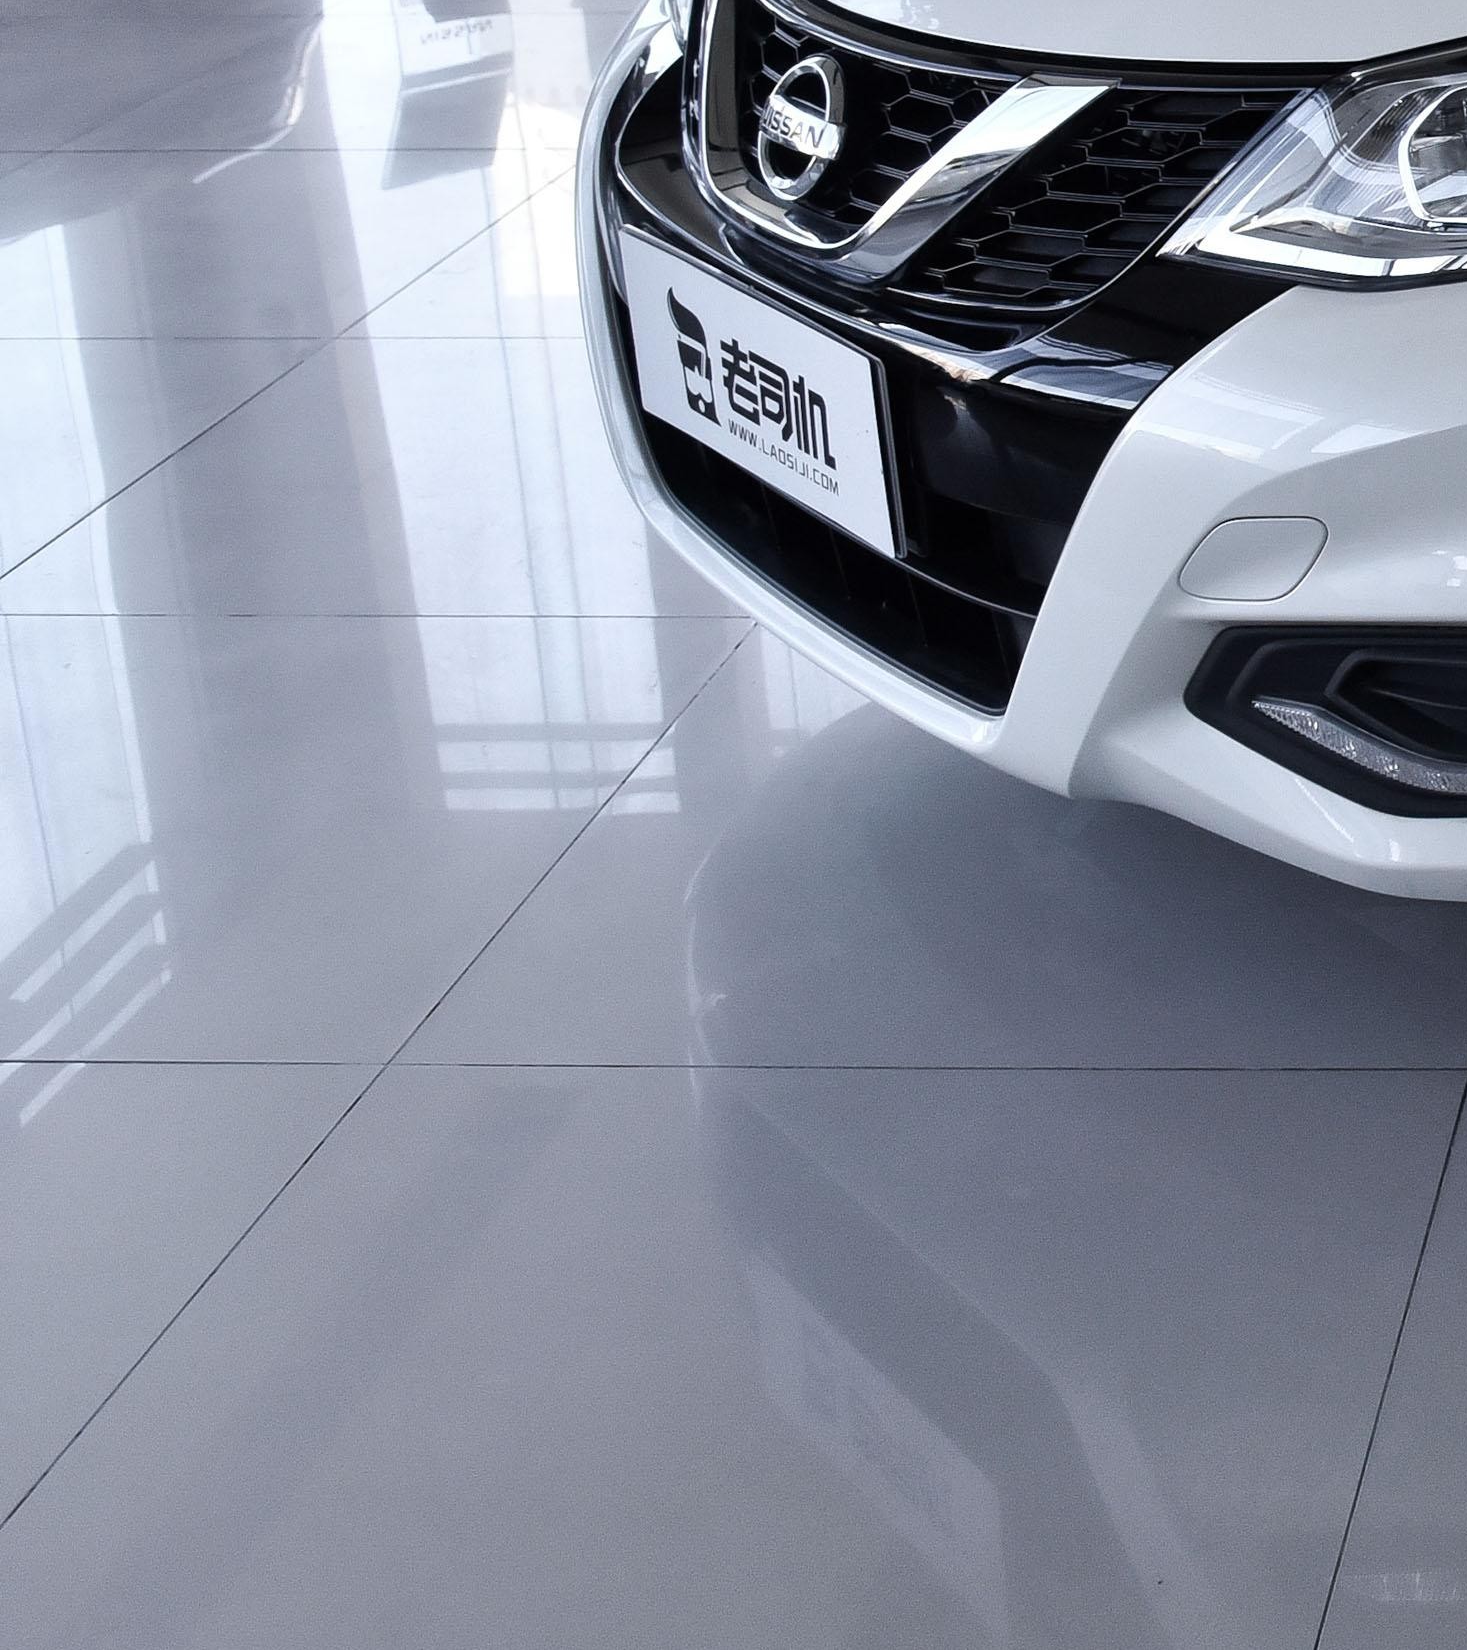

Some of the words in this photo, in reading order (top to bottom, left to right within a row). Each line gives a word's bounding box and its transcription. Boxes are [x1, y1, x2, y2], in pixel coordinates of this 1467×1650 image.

[720, 337, 837, 471] 老司机
[728, 419, 840, 497] WWW.LAOSIJI.COM
